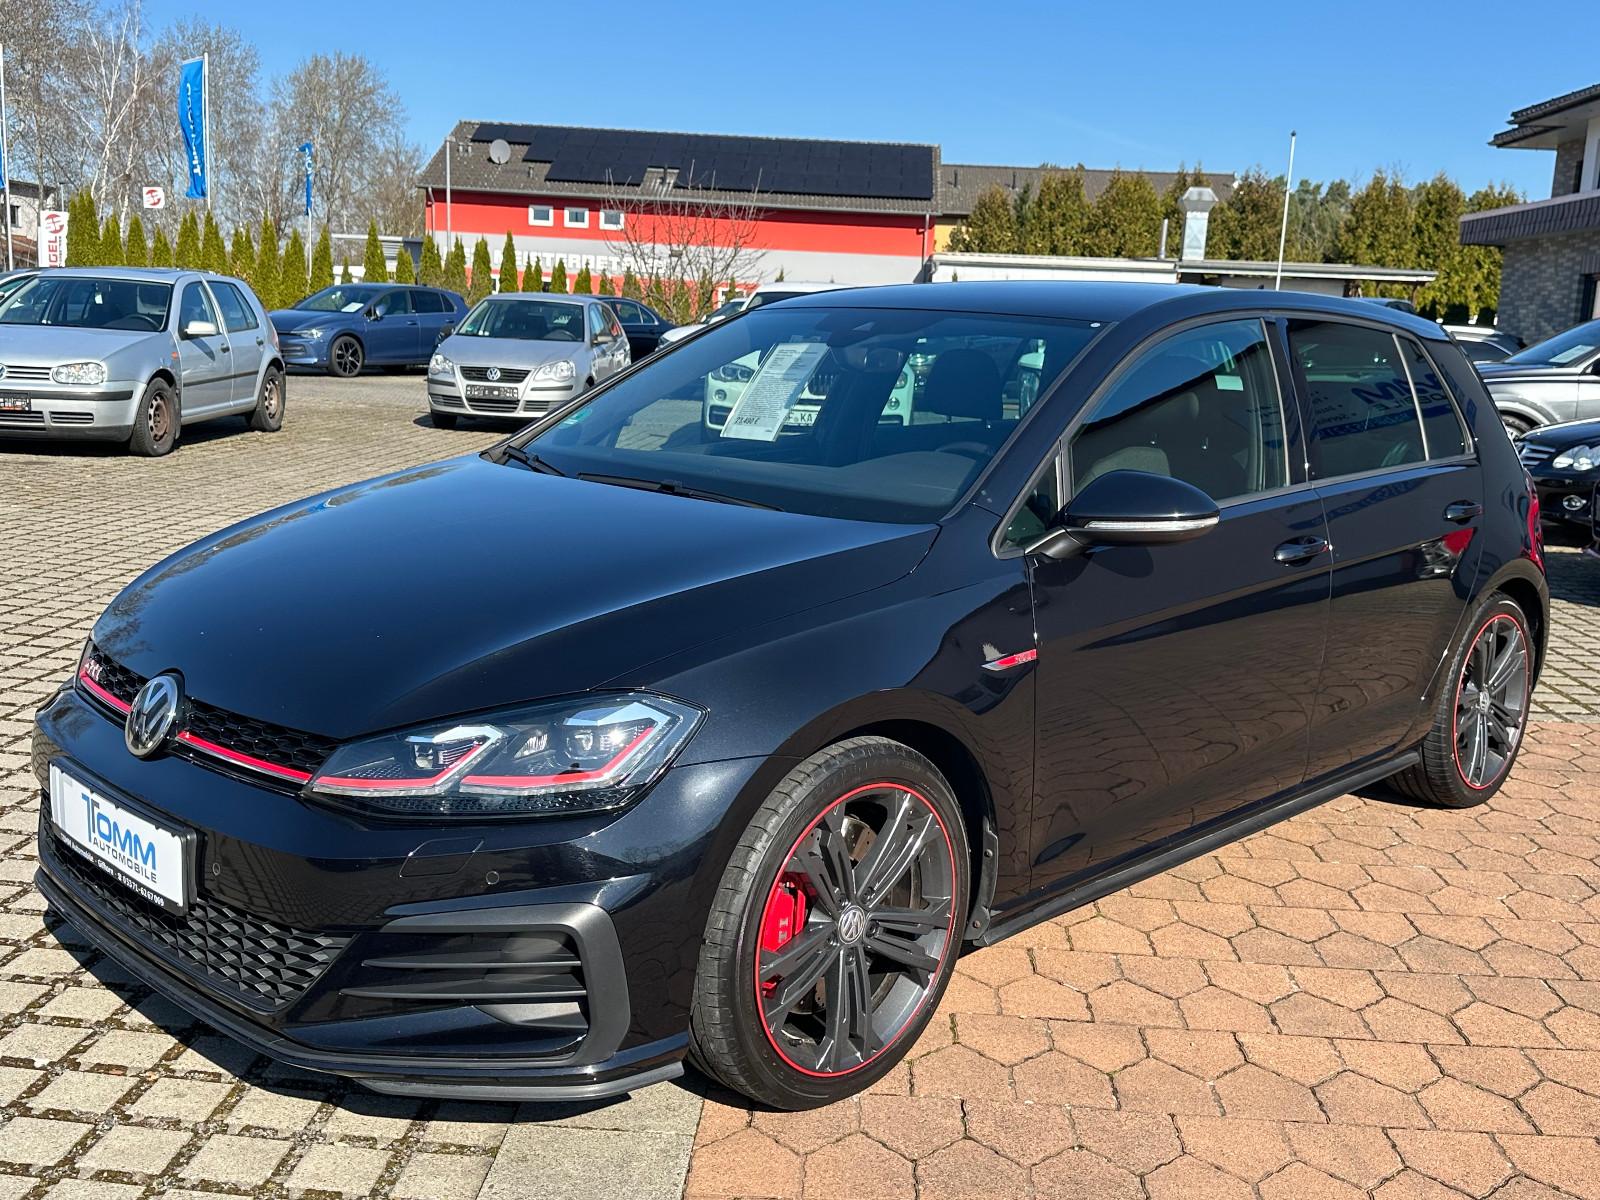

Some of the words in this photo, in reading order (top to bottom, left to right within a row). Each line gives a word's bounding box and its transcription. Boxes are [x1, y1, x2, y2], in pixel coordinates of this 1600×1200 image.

[800, 412, 813, 423] KA
[81, 792, 157, 871] TOMM
[93, 837, 158, 884] AUTOMOBILE
